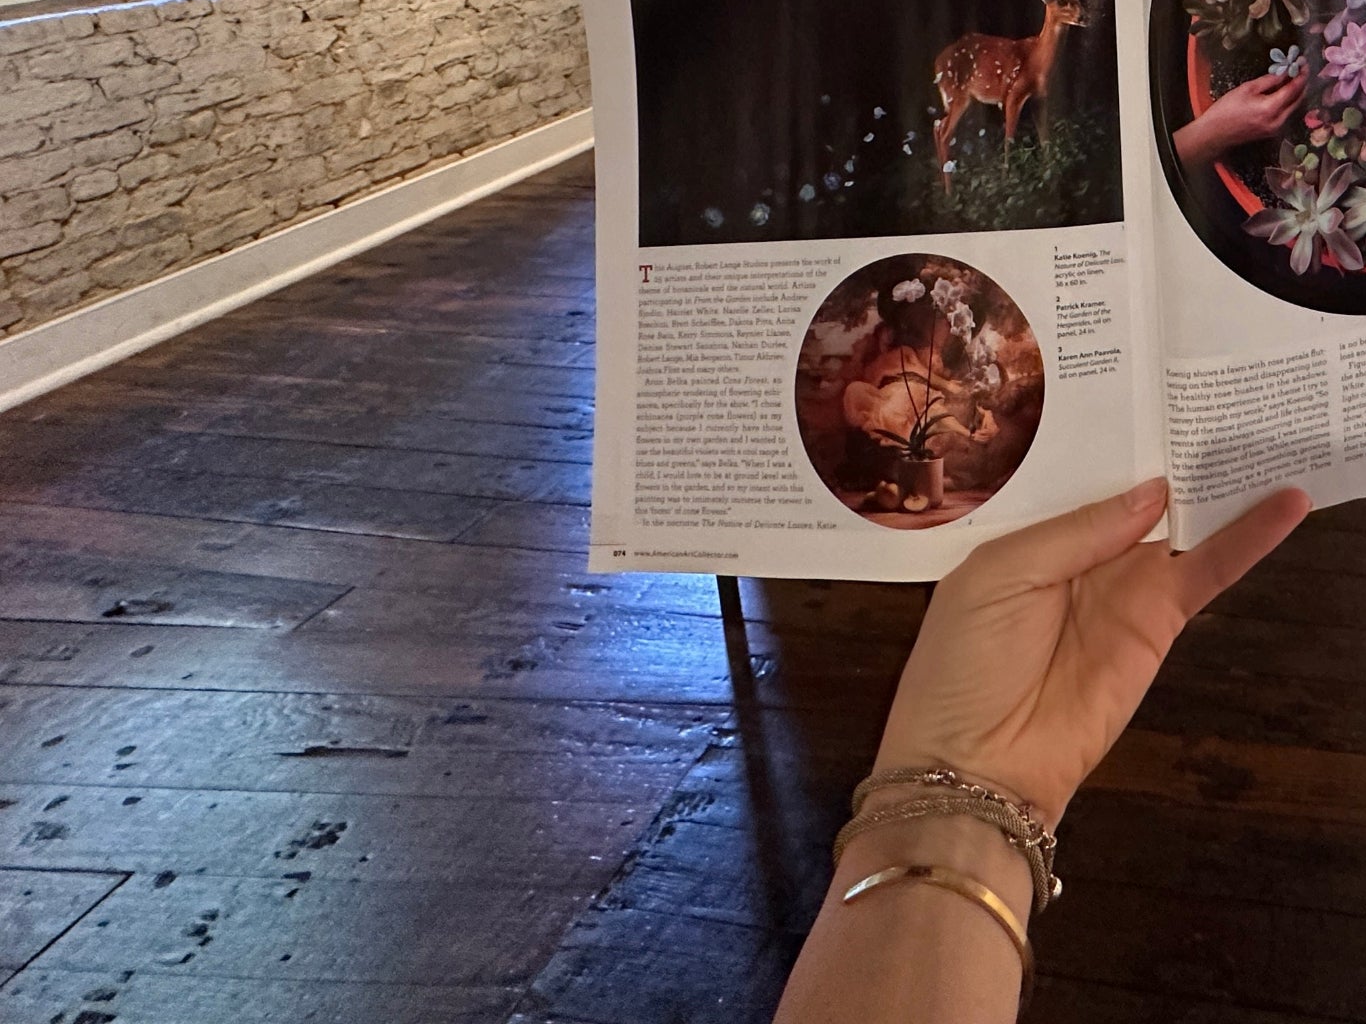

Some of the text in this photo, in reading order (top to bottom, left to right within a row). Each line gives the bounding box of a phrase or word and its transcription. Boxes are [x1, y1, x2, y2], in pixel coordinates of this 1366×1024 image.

[1085, 259, 1109, 267] Delicate
[1055, 271, 1076, 279] acrylic
[1059, 362, 1088, 370] Succulent
[1090, 358, 1112, 366] Garden
